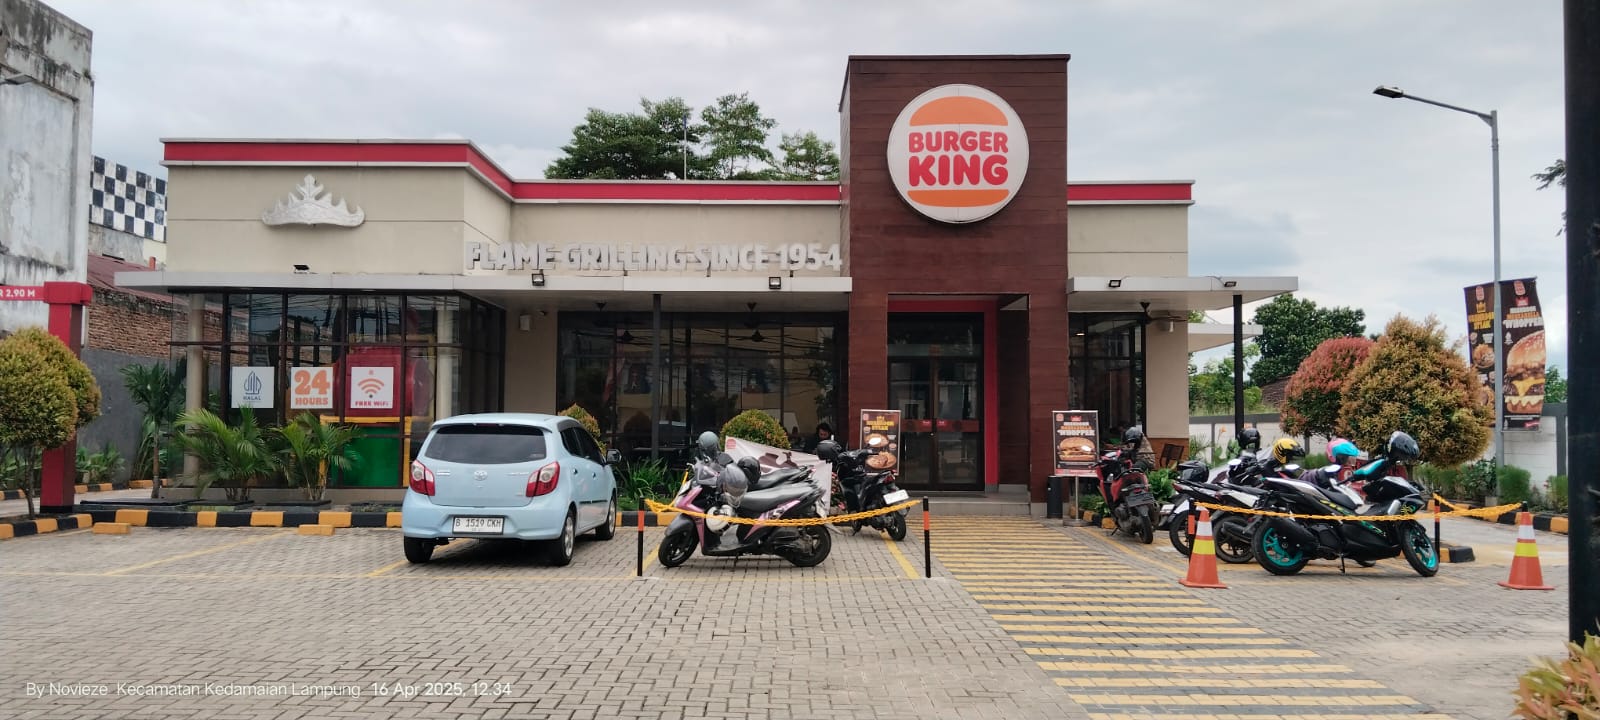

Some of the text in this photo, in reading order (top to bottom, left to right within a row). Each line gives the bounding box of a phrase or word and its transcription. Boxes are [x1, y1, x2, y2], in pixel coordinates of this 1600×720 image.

[908, 131, 1009, 153] BURGER
[908, 154, 1009, 187] KING
[465, 242, 843, 272] FLAME GRILLING SINCE 1954
[6, 289, 25, 297] 2.90
[28, 289, 35, 297] M
[294, 370, 331, 395] 24
[295, 397, 329, 406] HOURS
[455, 518, 461, 527] B
